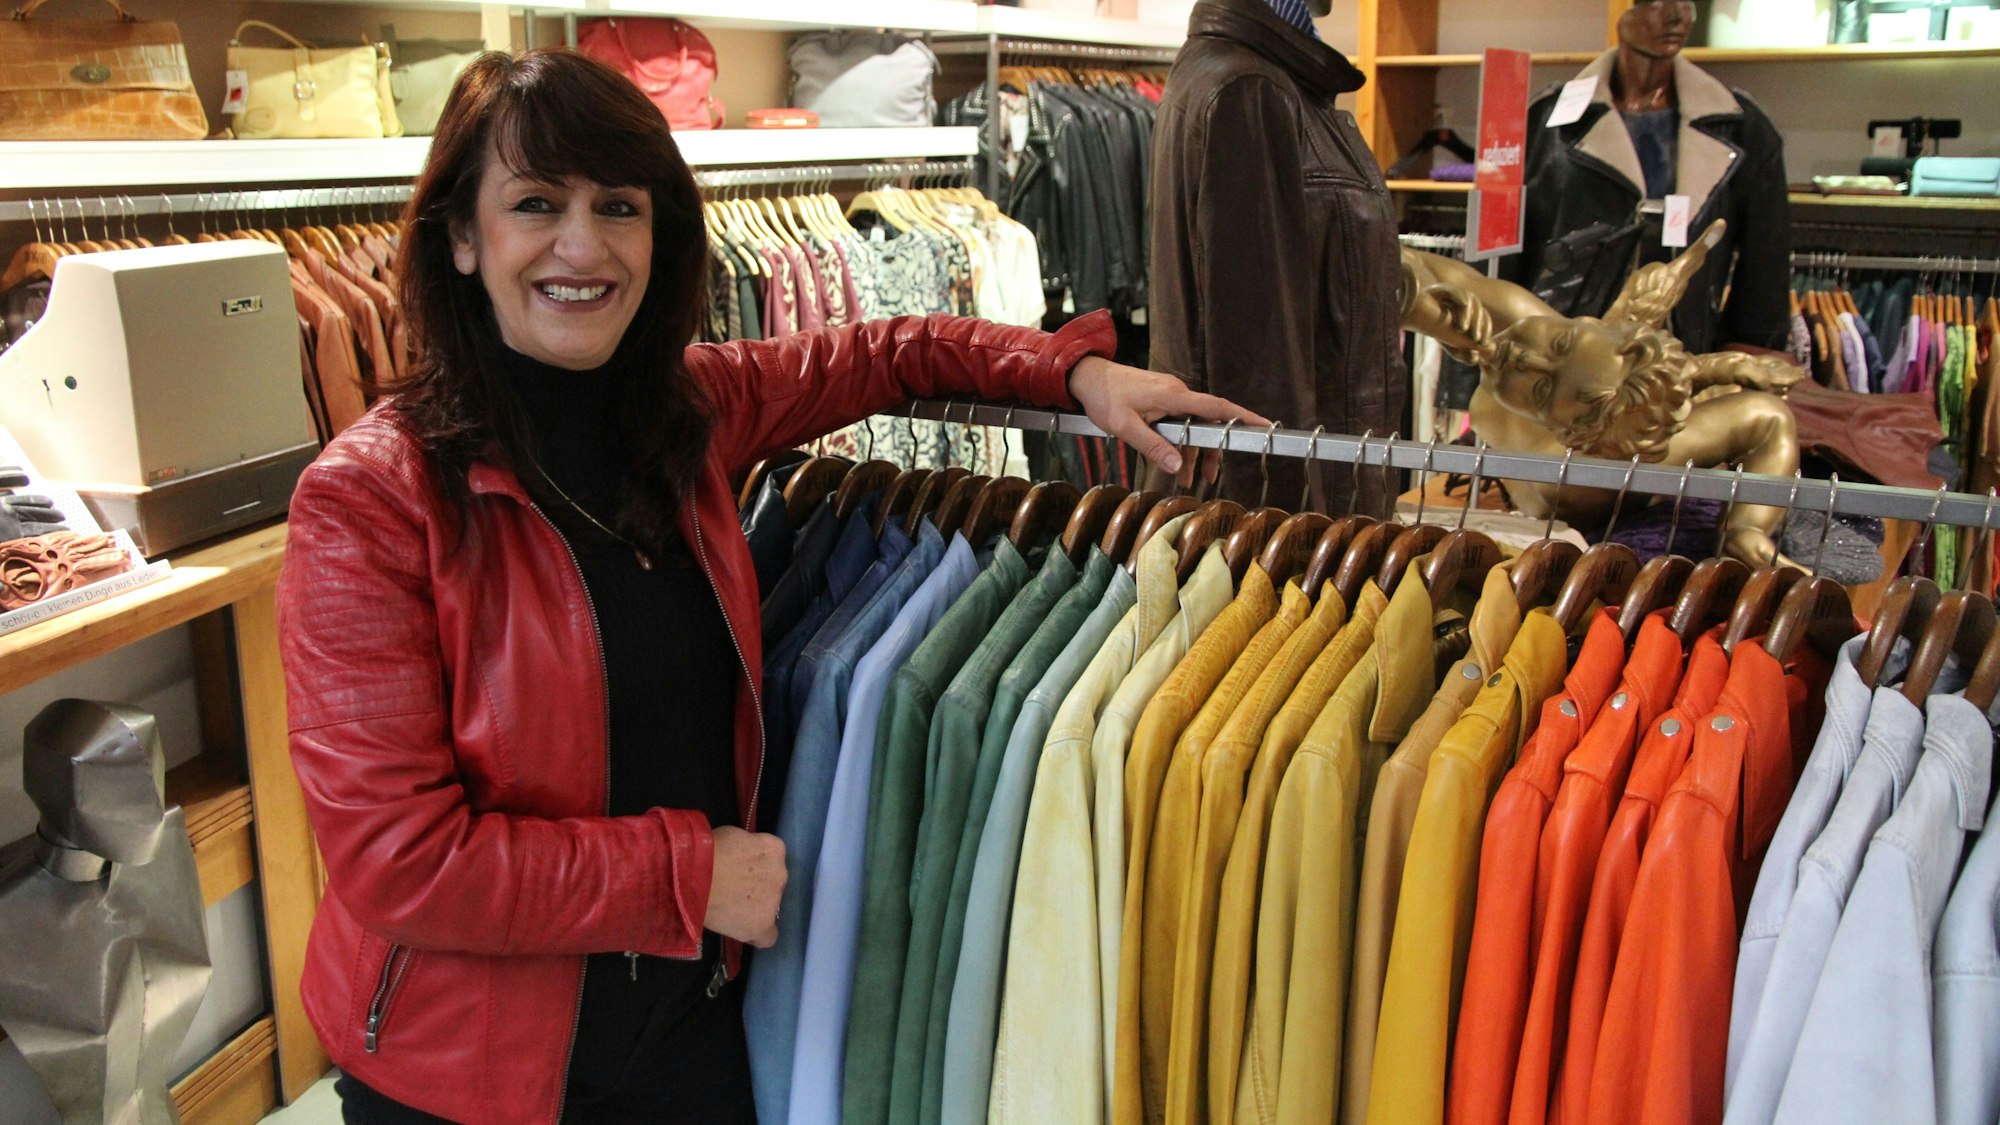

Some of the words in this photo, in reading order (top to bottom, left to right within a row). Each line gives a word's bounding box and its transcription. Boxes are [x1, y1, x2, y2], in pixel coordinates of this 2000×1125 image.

[1483, 140, 1521, 167] reduziert
[84, 585, 113, 601] Dinge
[115, 579, 132, 591] aus
